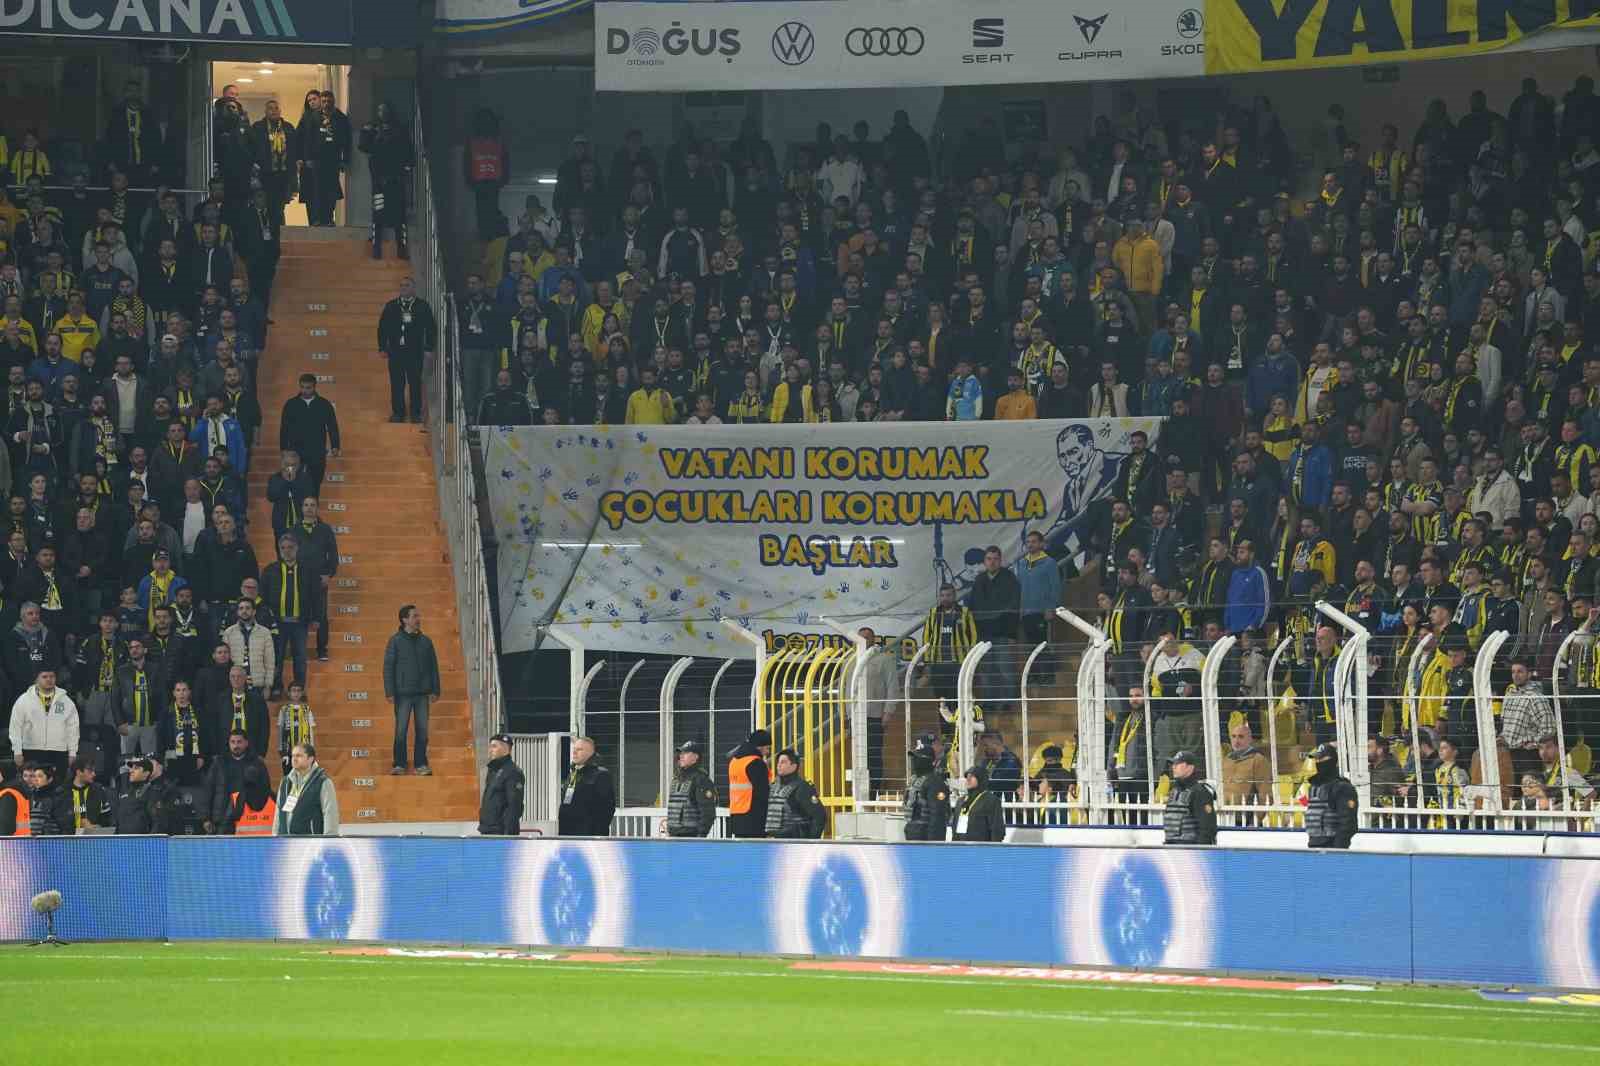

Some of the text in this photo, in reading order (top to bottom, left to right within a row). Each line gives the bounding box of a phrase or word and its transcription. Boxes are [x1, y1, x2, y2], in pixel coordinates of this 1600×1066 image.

[1233, 0, 1600, 62] YALN
[961, 53, 1015, 64] SEAT
[1058, 49, 1123, 61] CUPRA
[660, 445, 990, 481] VATANI KORUMAK
[601, 488, 1048, 530] ÇOCUKLARI KORUMAKLA
[759, 534, 898, 575] BAŞLAR
